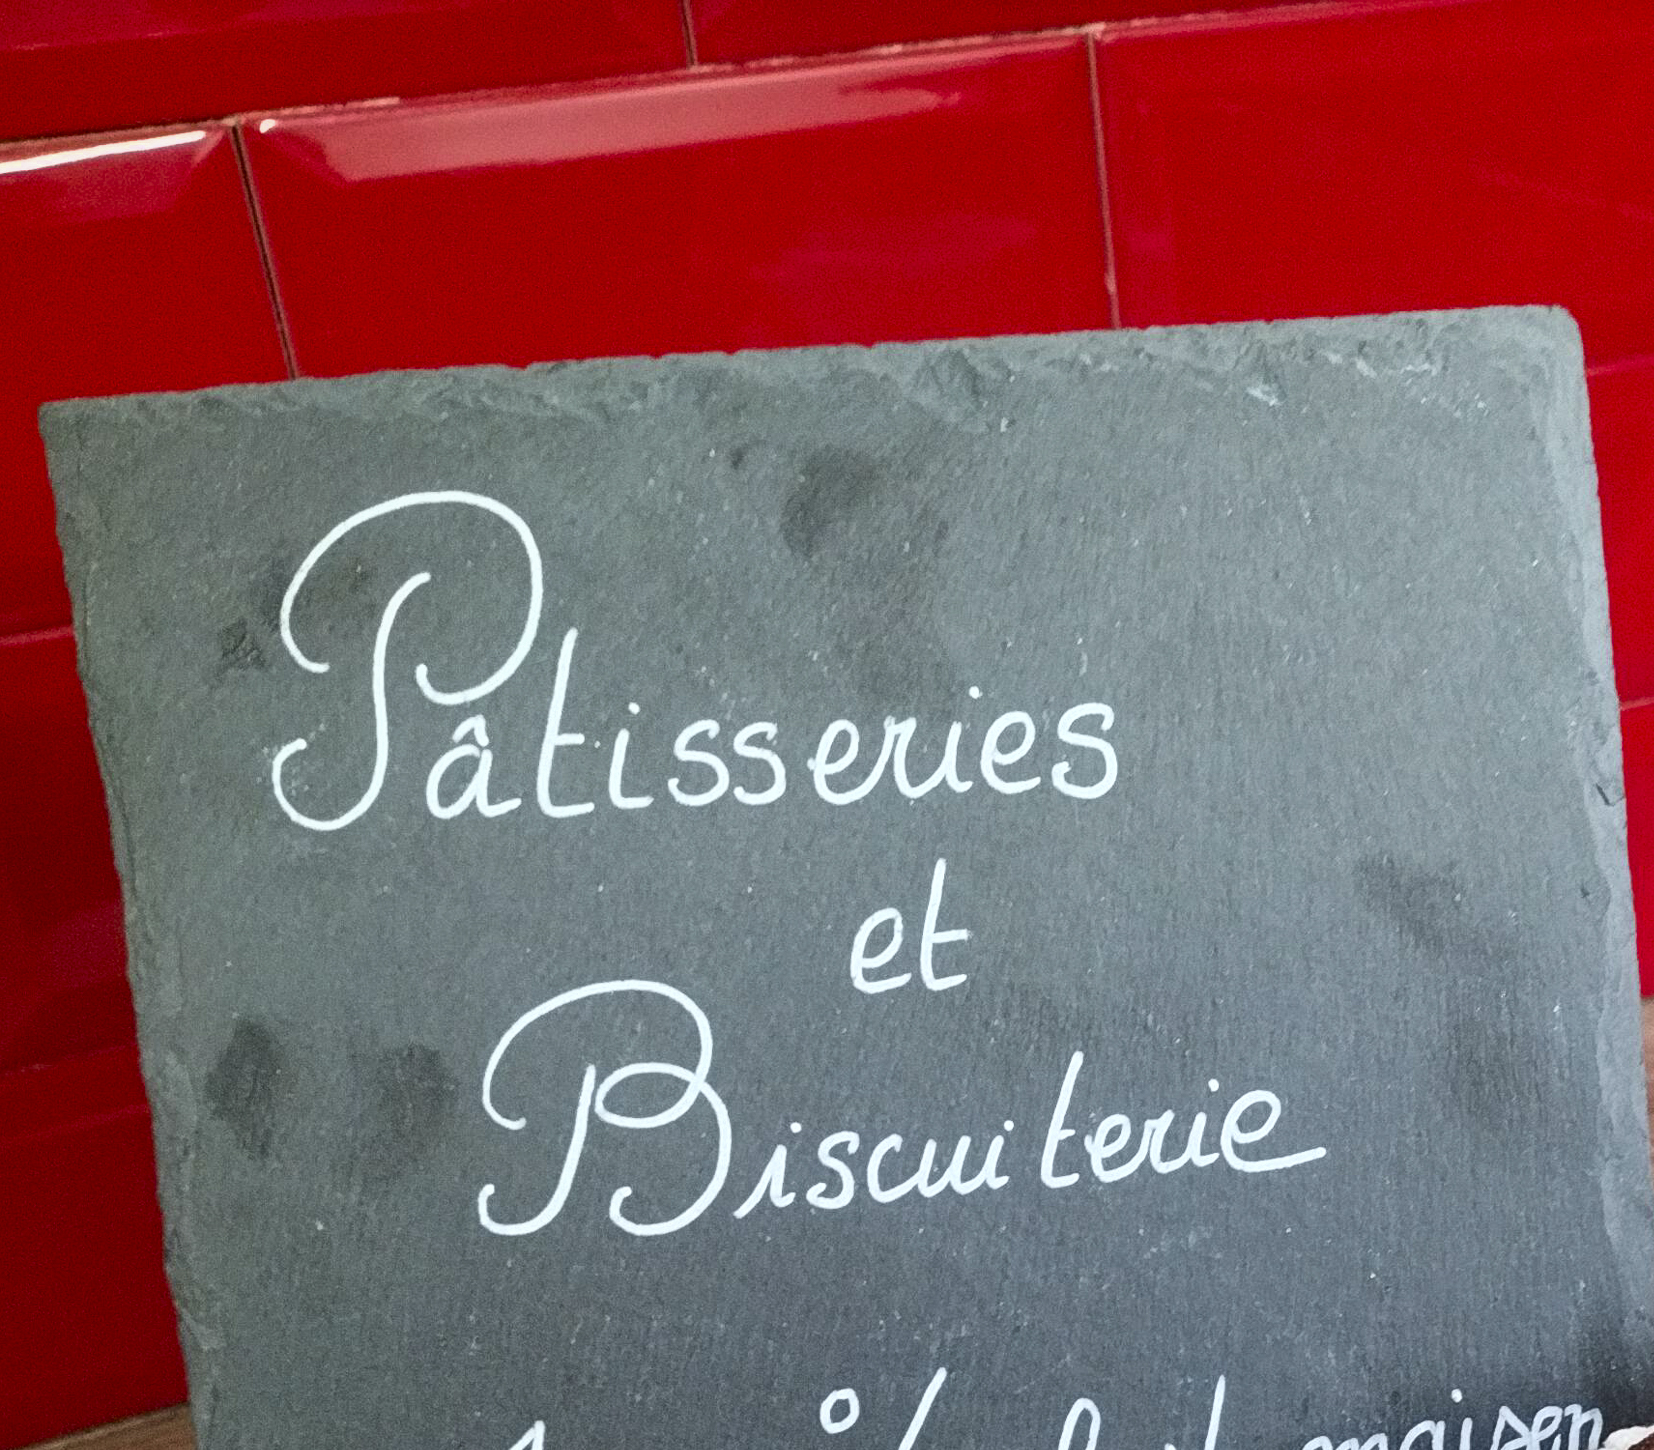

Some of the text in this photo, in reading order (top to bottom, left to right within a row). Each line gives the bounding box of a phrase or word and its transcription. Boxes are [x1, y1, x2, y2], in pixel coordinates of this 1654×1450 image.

[271, 490, 1118, 832] Pâtisseries
[849, 857, 972, 995] et
[477, 979, 1327, 1237] Biscuiterie
